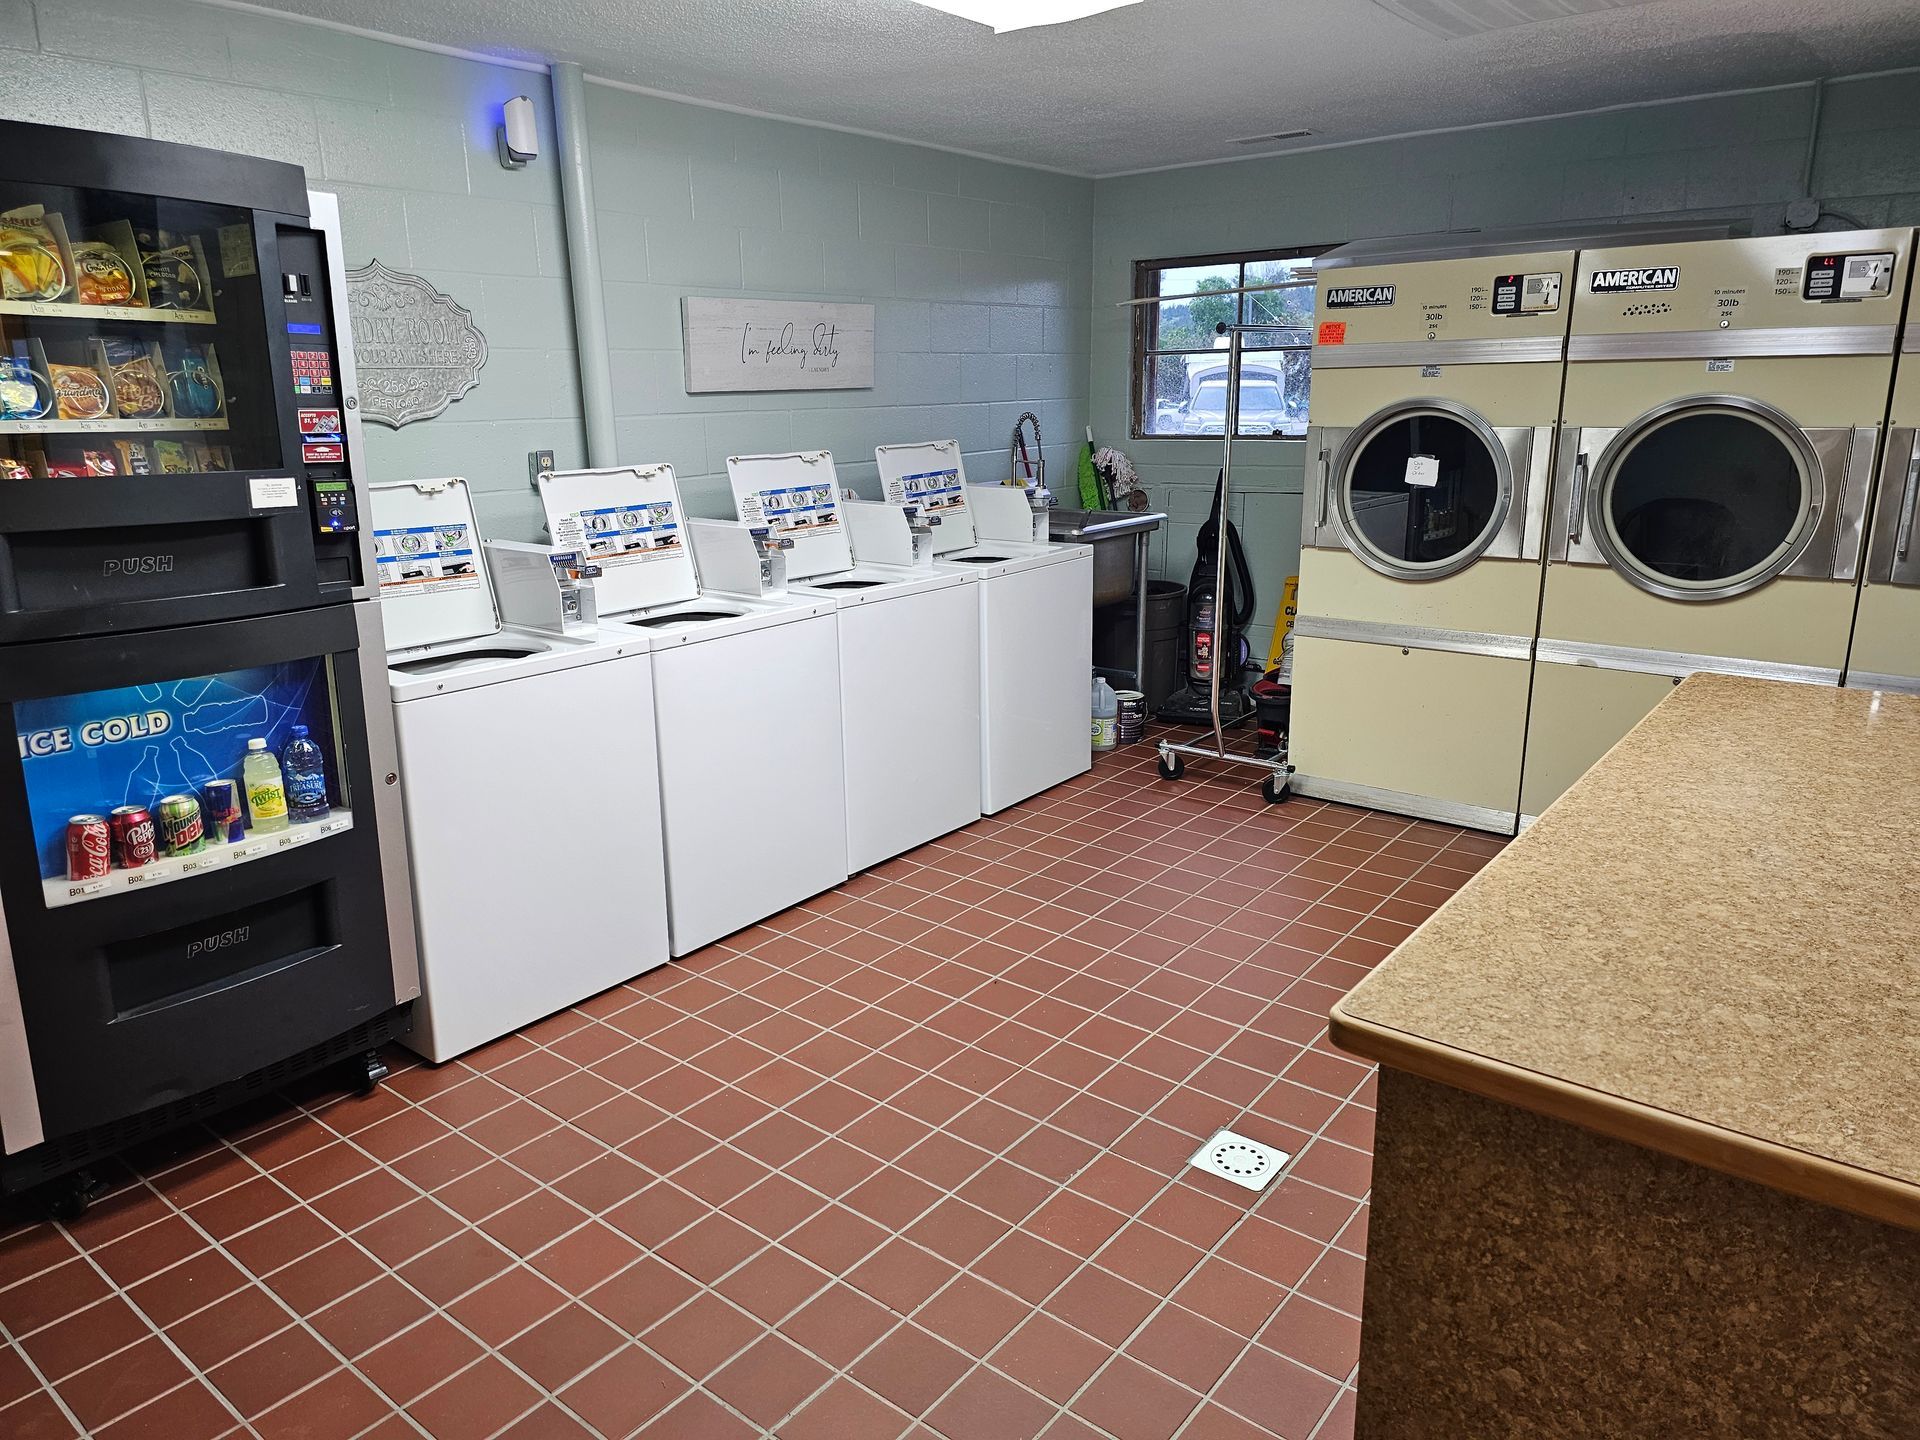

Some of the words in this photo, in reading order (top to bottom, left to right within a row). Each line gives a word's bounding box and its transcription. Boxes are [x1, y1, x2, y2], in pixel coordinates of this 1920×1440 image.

[1593, 268, 1677, 287] AMERICAN
[1328, 287, 1393, 303] AMERICAN
[1717, 298, 1739, 307] 30lb
[1425, 313, 1443, 321] 30lb
[404, 317, 459, 345] ROOM
[741, 322, 760, 364] I'm
[765, 322, 809, 369] feeling
[812, 322, 840, 367] dirty
[430, 350, 458, 364] HERE
[103, 555, 174, 577] PUSH
[17, 727, 73, 759] ICE
[80, 710, 171, 747] COLD
[289, 780, 324, 793] TREASURE
[251, 788, 282, 807] TWIST
[320, 825, 332, 834] B06
[279, 838, 291, 847] B05
[233, 850, 247, 860] B04
[182, 863, 197, 873] B03
[128, 875, 143, 885] B02
[69, 887, 85, 897] B01
[187, 926, 249, 959] PUSH
